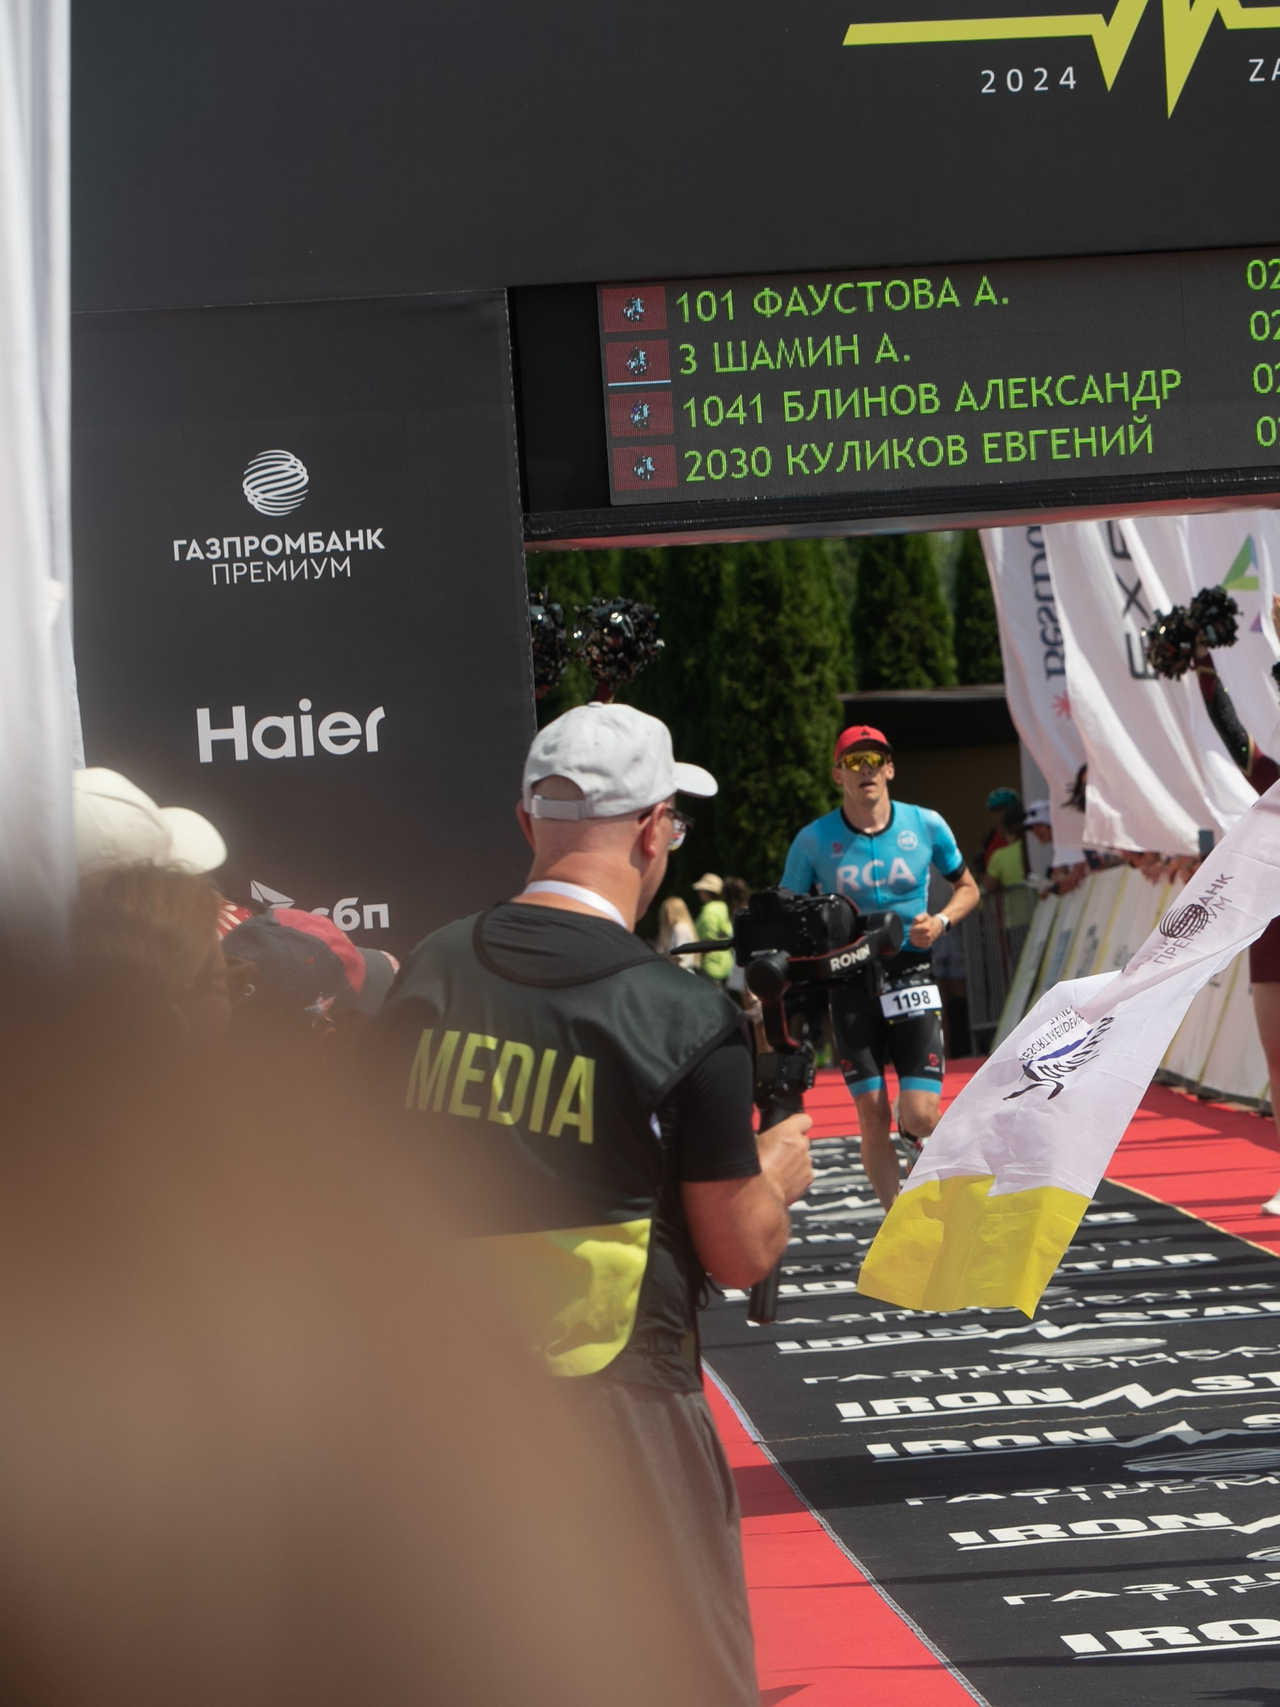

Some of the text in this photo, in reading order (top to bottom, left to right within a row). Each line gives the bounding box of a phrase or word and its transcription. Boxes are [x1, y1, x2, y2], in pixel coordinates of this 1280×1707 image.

[980, 66, 1077, 94] 2024
[676, 275, 1010, 324] 101 ФАУСТОВА А.
[679, 332, 912, 376] 3 ШАМИН А.
[682, 368, 1181, 428] 1041 БЛИНОВ АЛЕКСАНДР
[684, 415, 1154, 483] 2030 КУЛИКОВ ЕВГЕНИЙ
[172, 528, 386, 561] ГАЗПРОМБАНК
[211, 557, 352, 585] ПРЕМИУМ
[196, 698, 386, 763] Haier
[836, 857, 917, 894] RCA
[830, 944, 871, 972] RONIN
[892, 990, 931, 1010] 1198
[404, 1028, 596, 1145] MEDIA
[1054, 1253, 1218, 1273] TAR
[775, 1323, 989, 1352] IRON
[835, 1387, 1074, 1419] IRON
[866, 1427, 1118, 1459] IRON
[948, 1512, 1235, 1545] IRON
